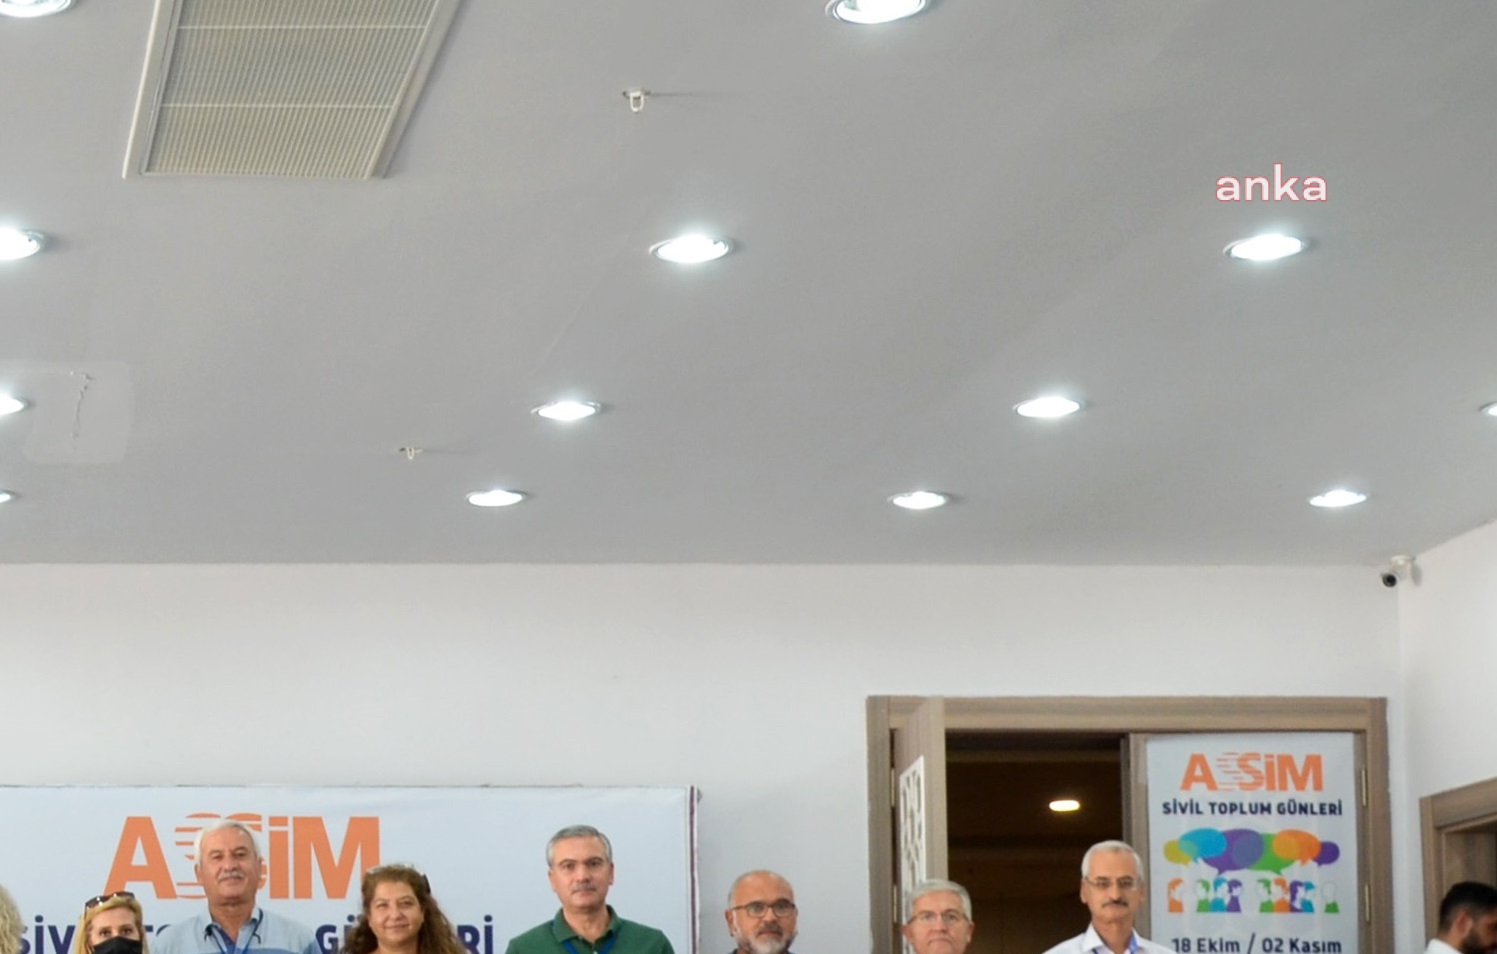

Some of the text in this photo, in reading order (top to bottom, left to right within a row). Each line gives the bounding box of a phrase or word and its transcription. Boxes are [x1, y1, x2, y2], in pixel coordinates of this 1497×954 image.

[1162, 799, 1343, 816] SİVİL TOPLUM GÜNLERİ
[1171, 938, 1191, 953] 18
[1197, 937, 1240, 953] Ekim
[1262, 938, 1284, 953] 02
[1289, 938, 1342, 954] Kasım
